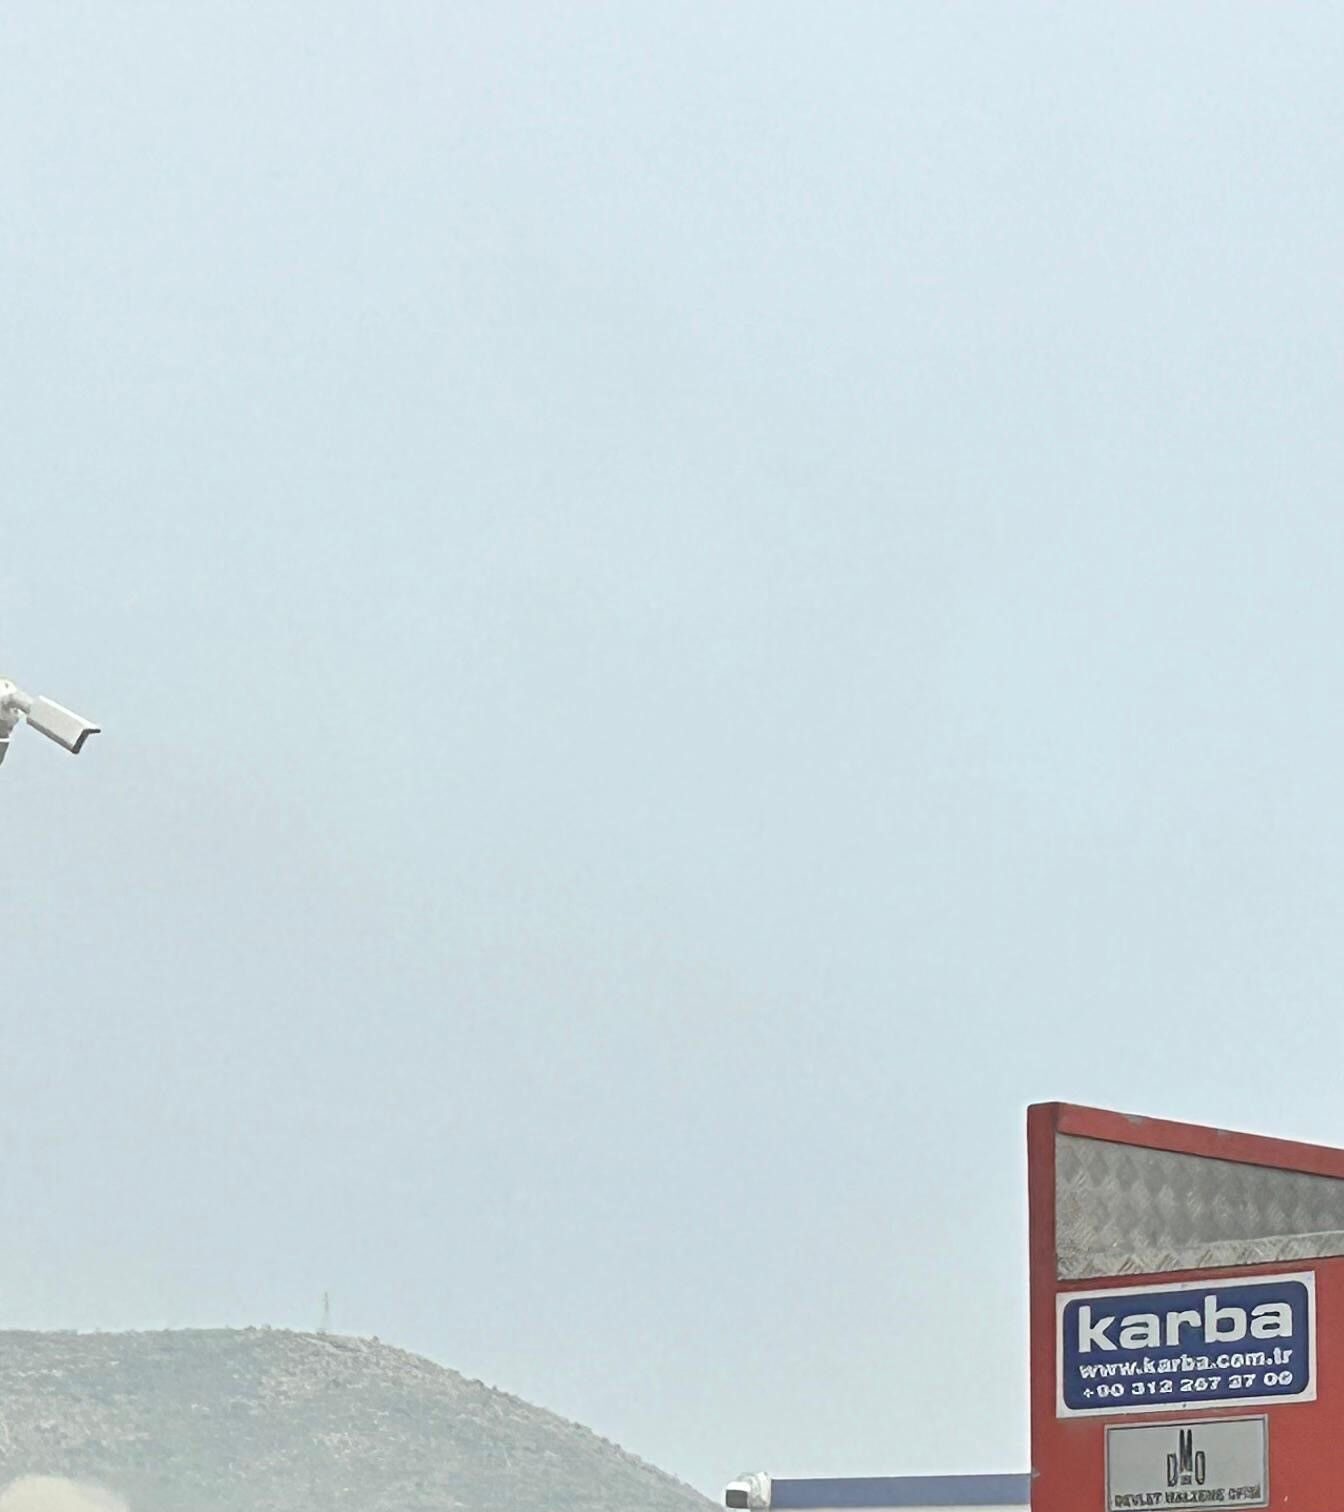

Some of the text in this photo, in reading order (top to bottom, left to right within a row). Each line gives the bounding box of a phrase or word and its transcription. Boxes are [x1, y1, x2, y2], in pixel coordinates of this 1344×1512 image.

[1077, 1294, 1294, 1354] karba
[1079, 1347, 1293, 1380] www.karba.com.tr
[1263, 1370, 1293, 1387] 00
